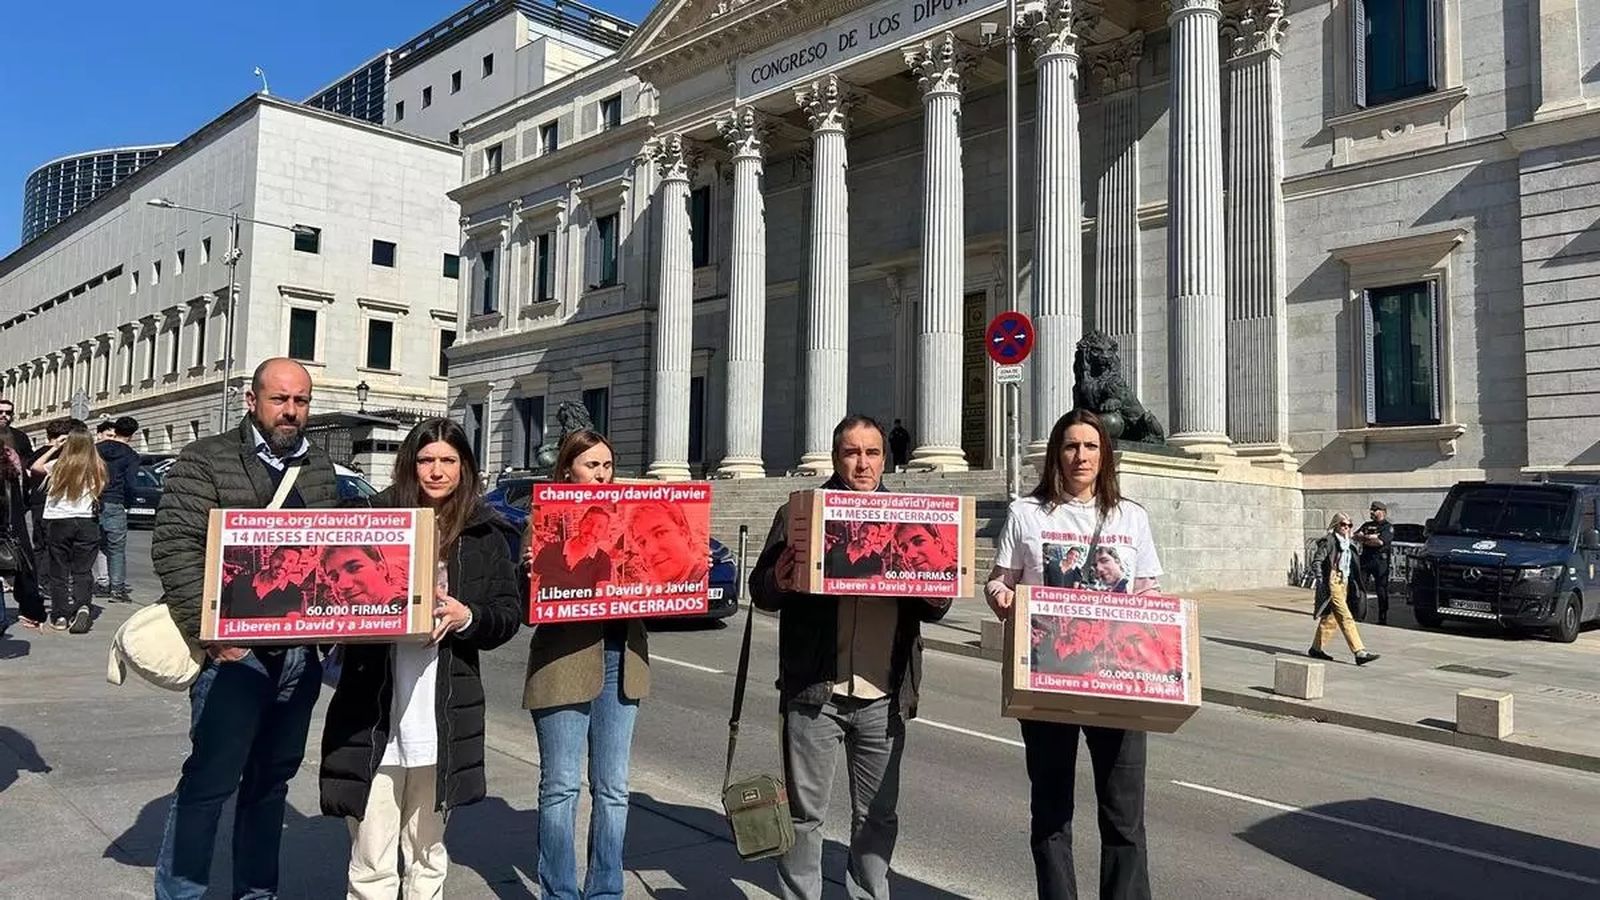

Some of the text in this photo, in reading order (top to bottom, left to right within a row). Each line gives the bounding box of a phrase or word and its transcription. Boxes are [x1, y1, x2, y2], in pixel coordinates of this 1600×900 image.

[751, 0, 968, 84] CONGRESO DE LOS DIPU
[540, 487, 706, 503] change.org/davidYjavier
[829, 494, 954, 509] change.org/davidYjavier
[231, 512, 407, 528] change.org/davidYjavier
[830, 509, 955, 522] 14 MESES ENCERRADOS
[231, 531, 405, 543] 14 MESES ENCERRADOS
[885, 571, 955, 581] 60.000 FIRMAS:
[537, 587, 592, 602] ¡Liberen
[596, 589, 603, 597] a
[606, 584, 642, 597] David
[645, 586, 653, 597] y
[655, 586, 663, 594] a
[665, 582, 704, 594] Javier!
[828, 580, 868, 592] ¡Liberen
[878, 581, 906, 591] David
[907, 584, 914, 593] y
[916, 584, 922, 592] a
[923, 582, 954, 592] Javier!
[536, 597, 704, 619] 14 MESES ENCERRADOS
[1035, 590, 1175, 610] change.org/davidYjavier
[306, 605, 402, 616] 60.000 FIRMAS:
[1036, 603, 1176, 623] 14 MESES ENCERRADOS
[224, 619, 402, 635] ¡Liberen a David y a Javier!
[1099, 669, 1135, 680] 60.000
[1035, 675, 1080, 688] ¡Liberen
[1082, 681, 1089, 689] a
[1091, 679, 1123, 691] David
[1125, 684, 1132, 694] y
